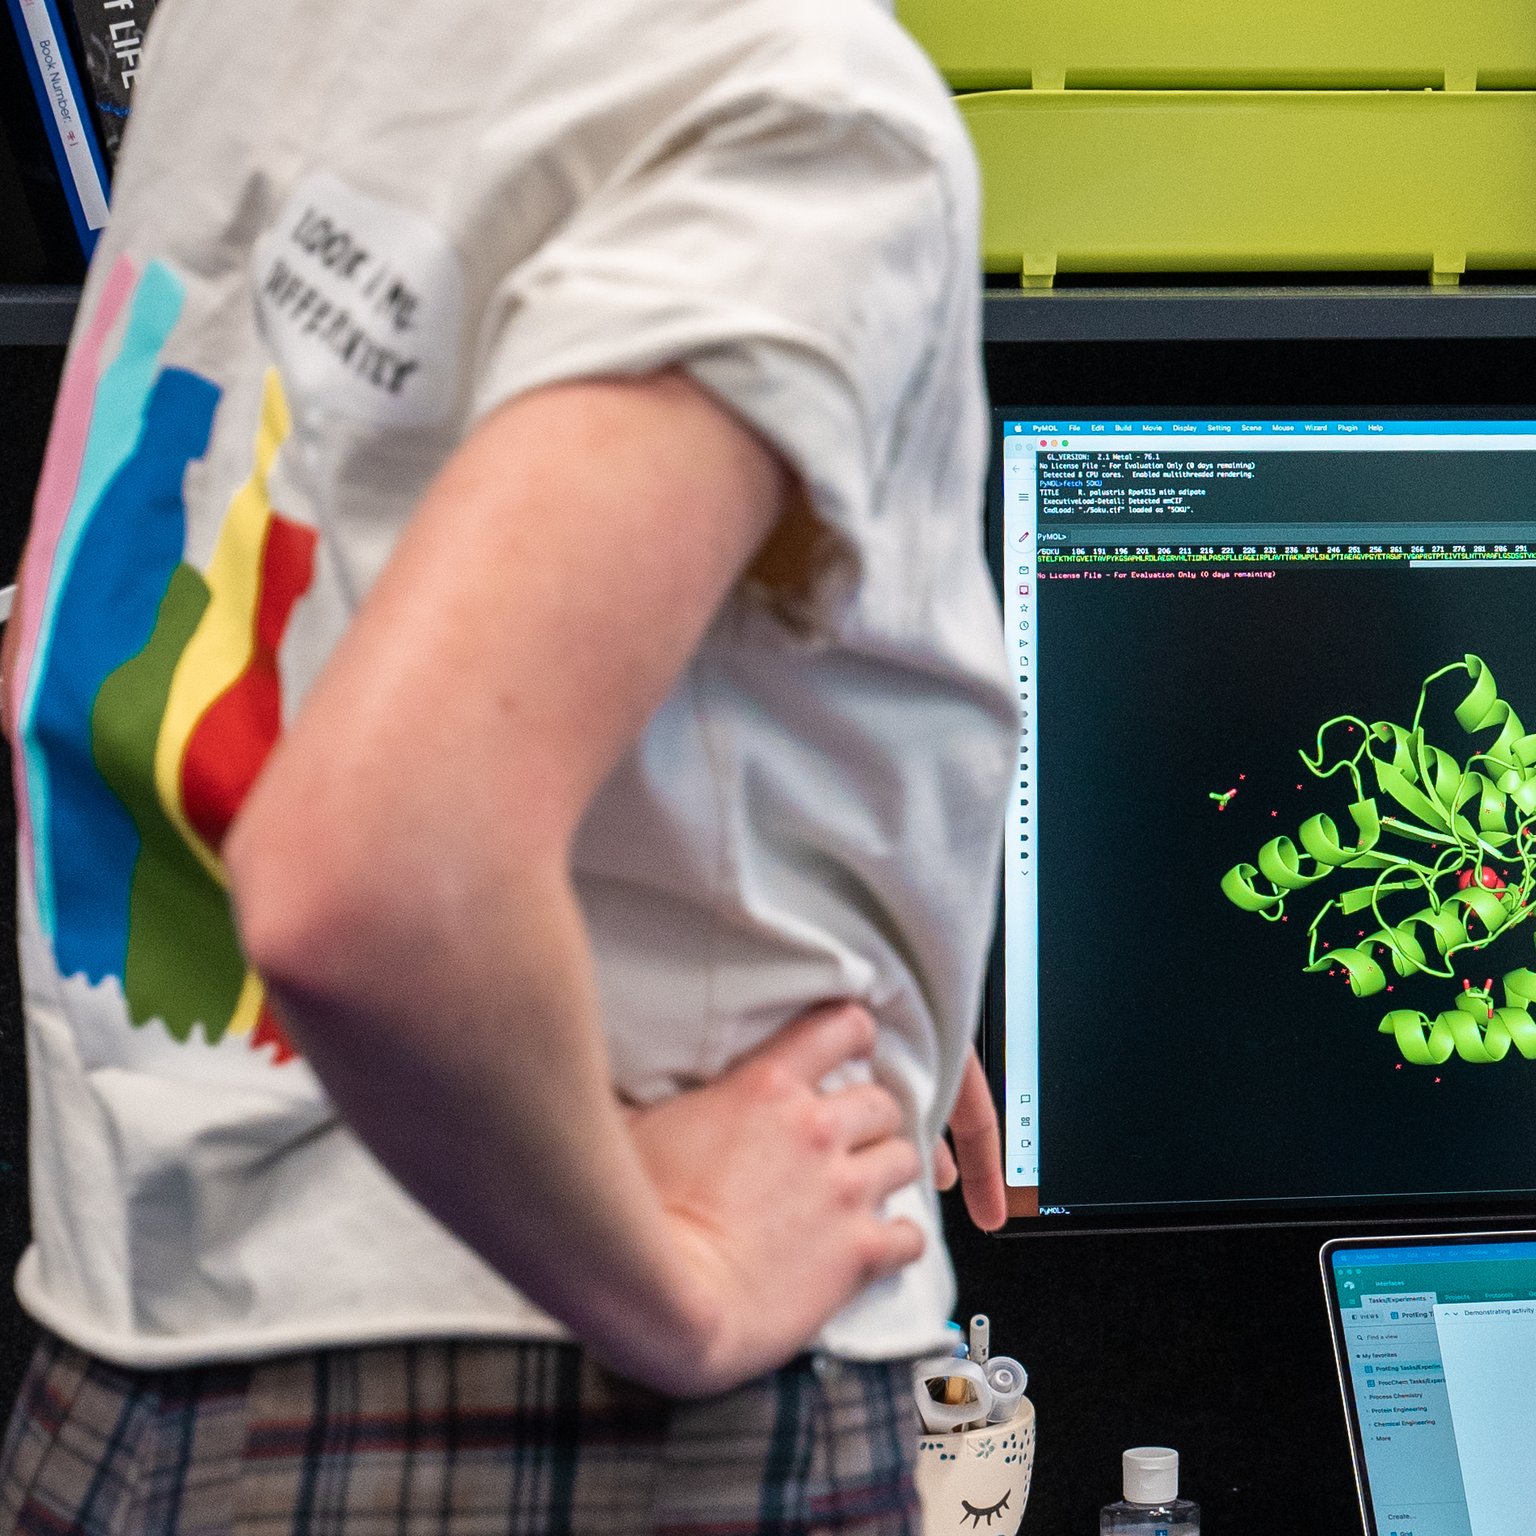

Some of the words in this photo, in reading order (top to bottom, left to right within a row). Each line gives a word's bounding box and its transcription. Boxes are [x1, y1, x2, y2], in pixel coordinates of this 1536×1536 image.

[40, 40, 54, 70] Book
[49, 71, 72, 123] Number:
[1217, 462, 1255, 470] remaining)
[1090, 489, 1124, 497] palustris
[1179, 489, 1206, 497] adipate
[1369, 1296, 1426, 1304] Tasks/Experiments
[1512, 1307, 1534, 1315] activity
